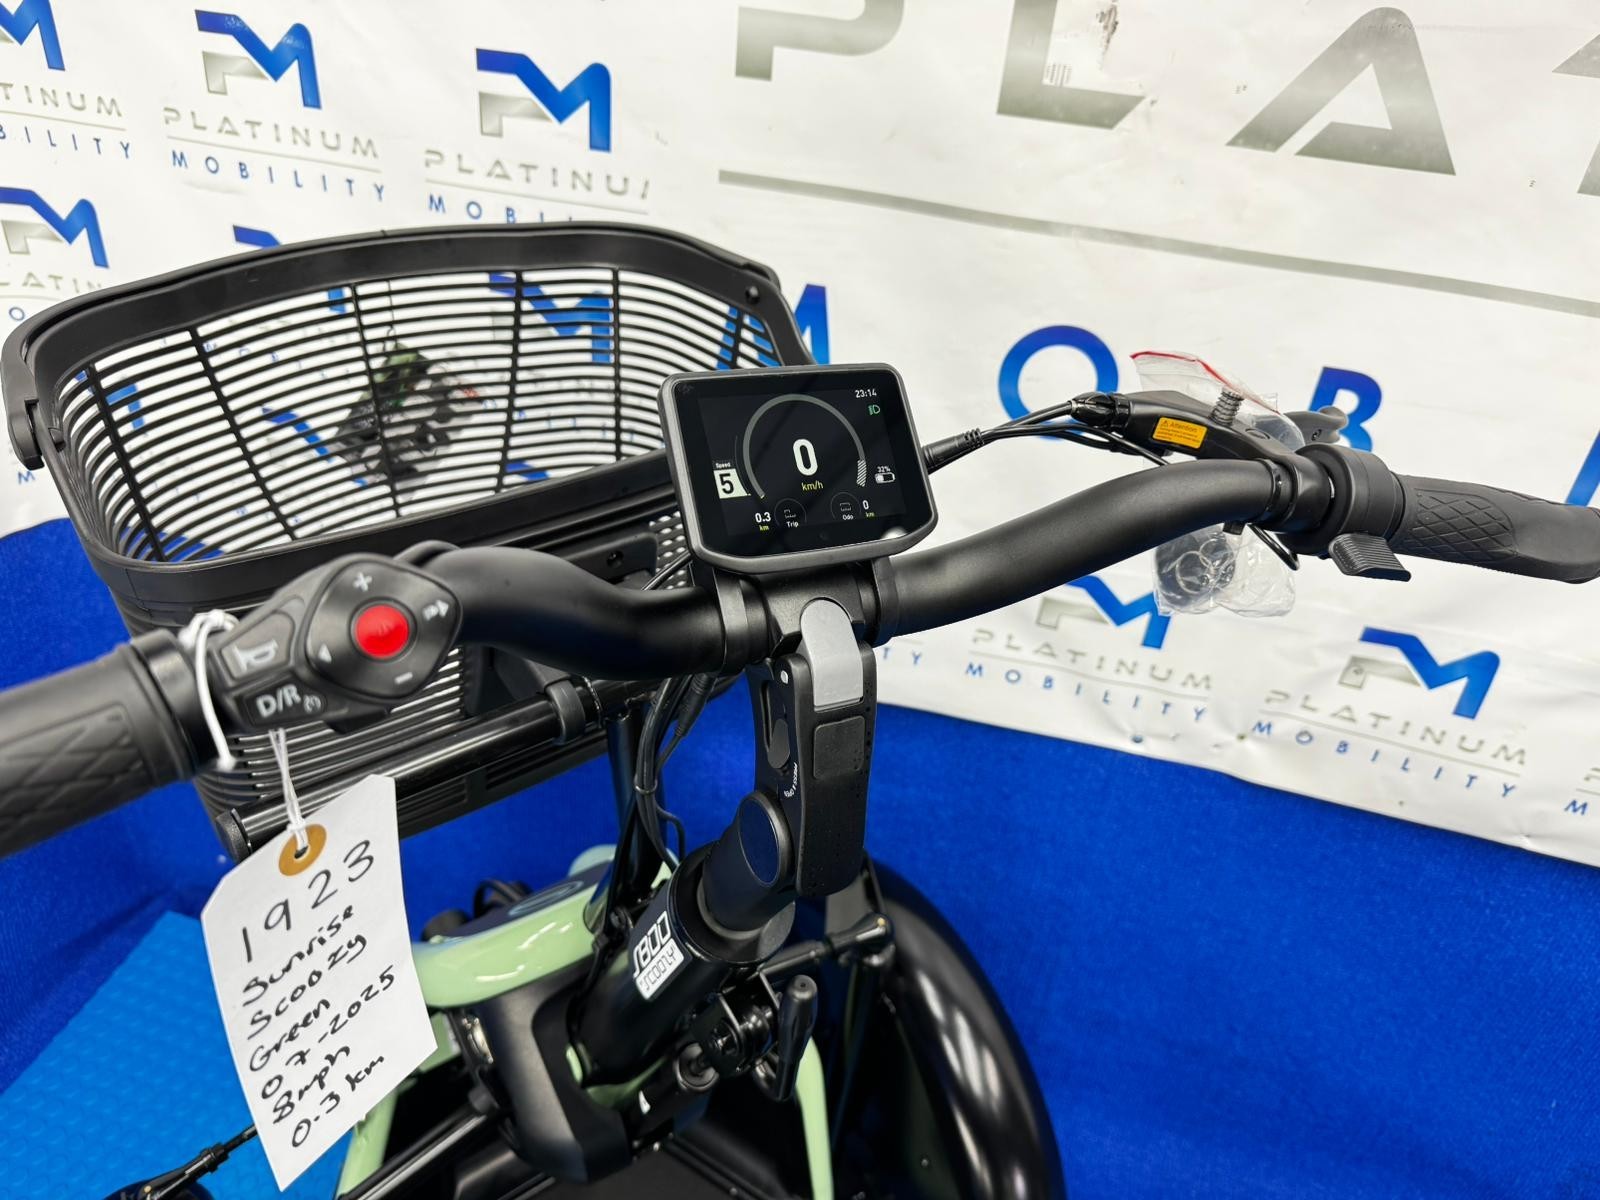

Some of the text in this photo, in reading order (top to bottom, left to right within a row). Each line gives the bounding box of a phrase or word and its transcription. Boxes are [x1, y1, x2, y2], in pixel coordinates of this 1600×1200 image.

[163, 106, 378, 158] PLATINUM
[172, 150, 384, 201] MOBILITY
[428, 194, 573, 224] MOBI
[855, 389, 877, 399] 23:14
[793, 438, 818, 476] 0
[719, 473, 734, 495] 5
[801, 480, 824, 491] km/h
[862, 500, 870, 510] 0
[755, 511, 771, 523] 0.3
[972, 628, 1213, 690] PLATINUM
[256, 683, 301, 718] D/R
[966, 662, 1206, 722] MOBILITY
[1264, 689, 1527, 765] PLATINUM
[1253, 720, 1515, 798] MOBILITY
[242, 839, 375, 963] 1923
[242, 905, 354, 1008] Sunrise
[249, 998, 331, 1072] Green
[272, 1045, 351, 1124] 8mph
[345, 1055, 385, 1092] km
